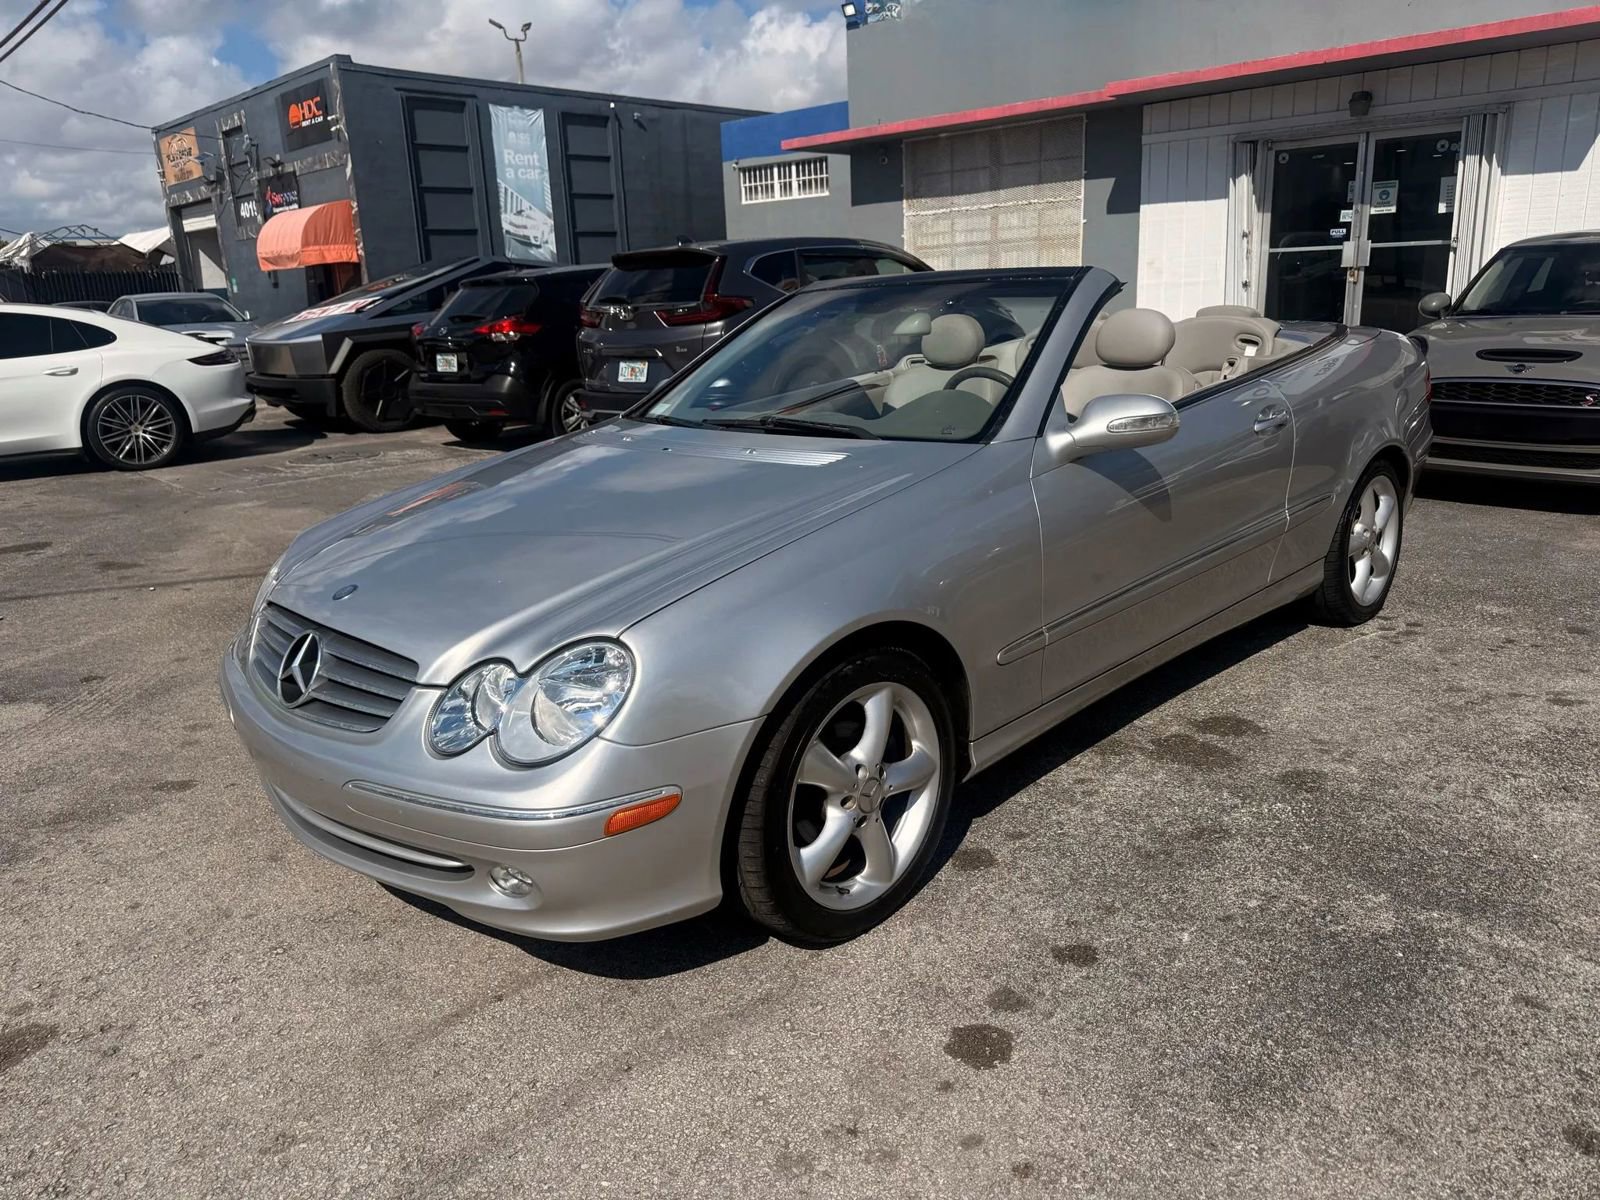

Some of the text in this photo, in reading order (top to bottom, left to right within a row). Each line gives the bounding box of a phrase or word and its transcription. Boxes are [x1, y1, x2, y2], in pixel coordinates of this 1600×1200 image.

[298, 97, 322, 120] HDC
[504, 148, 539, 166] Rent
[505, 167, 541, 180] a car
